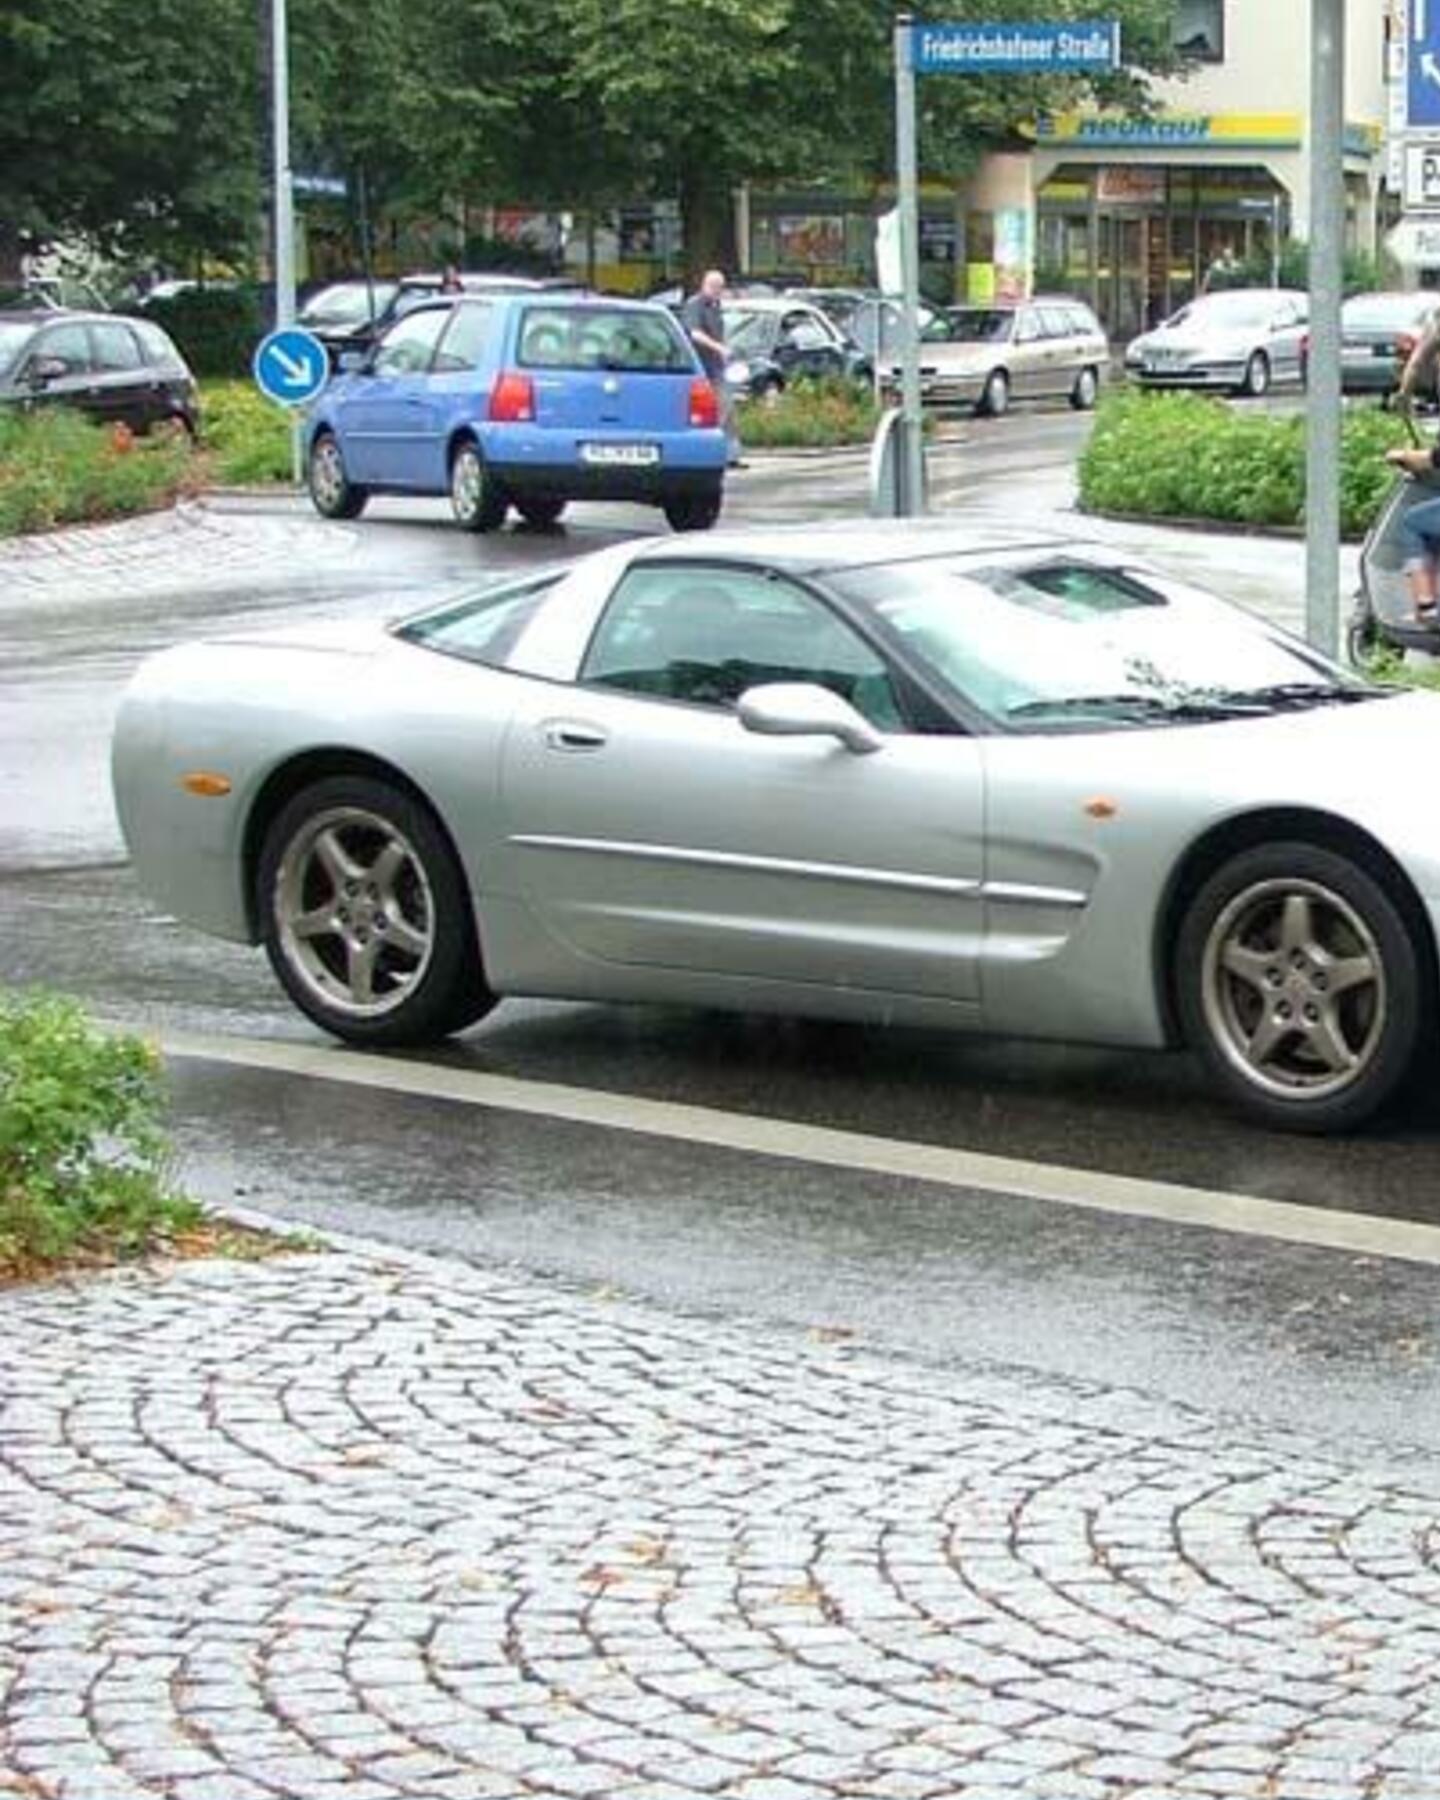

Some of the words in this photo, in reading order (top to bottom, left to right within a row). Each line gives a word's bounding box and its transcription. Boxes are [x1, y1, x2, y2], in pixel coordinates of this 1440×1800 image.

[922, 33, 1053, 59] Friedrichshafener
[1057, 32, 1110, 59] Straße
[1076, 114, 1212, 139] neukauf
